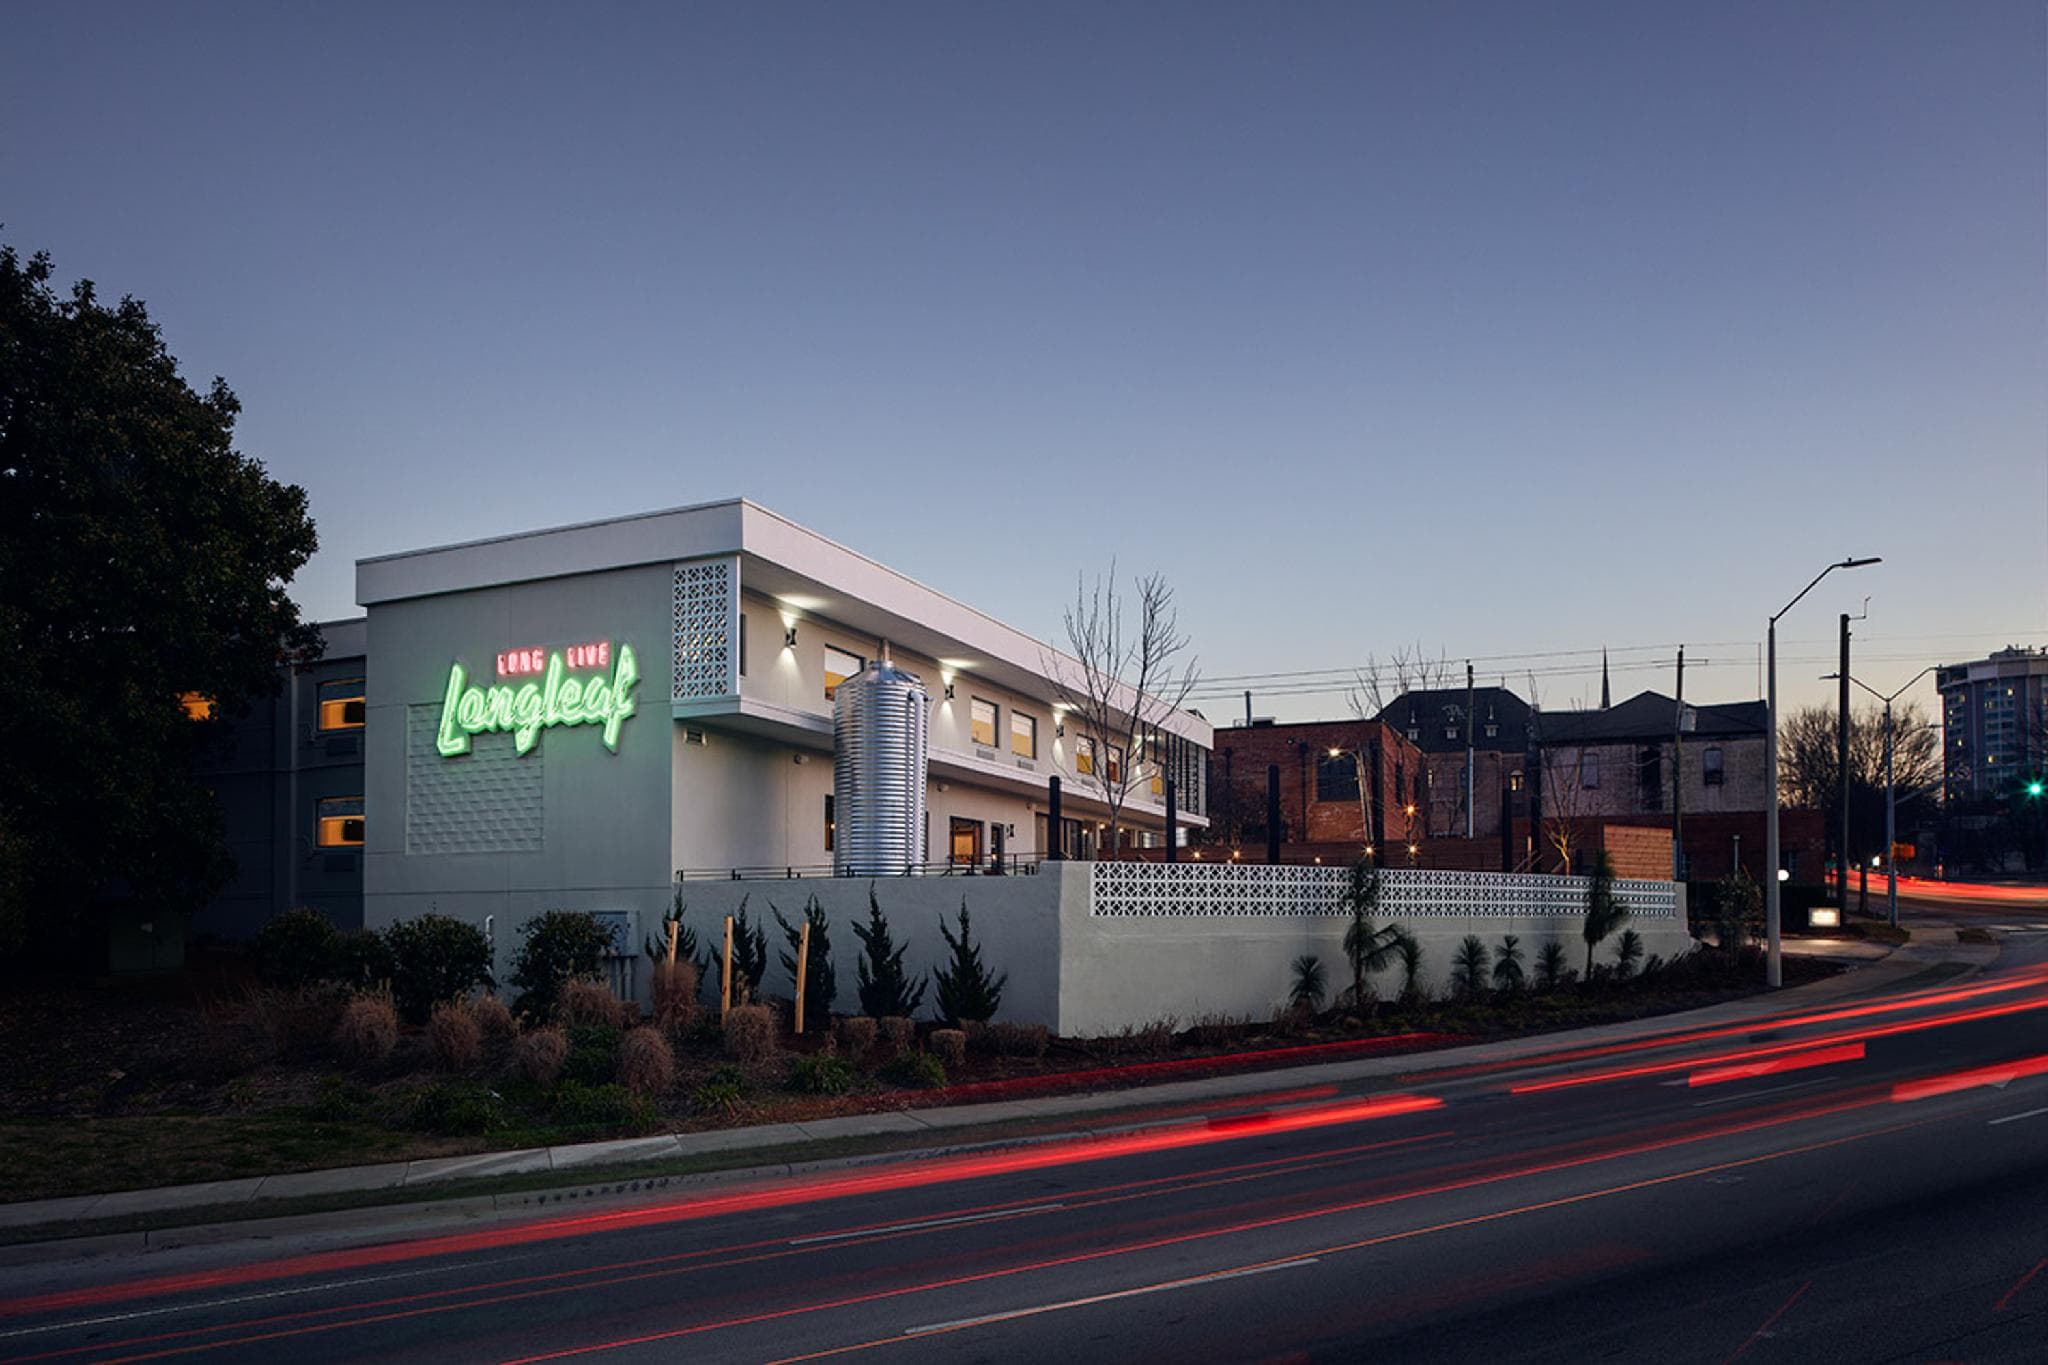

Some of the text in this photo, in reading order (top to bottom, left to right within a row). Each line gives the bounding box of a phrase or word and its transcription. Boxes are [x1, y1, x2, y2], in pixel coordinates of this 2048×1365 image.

[497, 642, 608, 675] LONG LIVE
[437, 644, 637, 757] Longleaf
